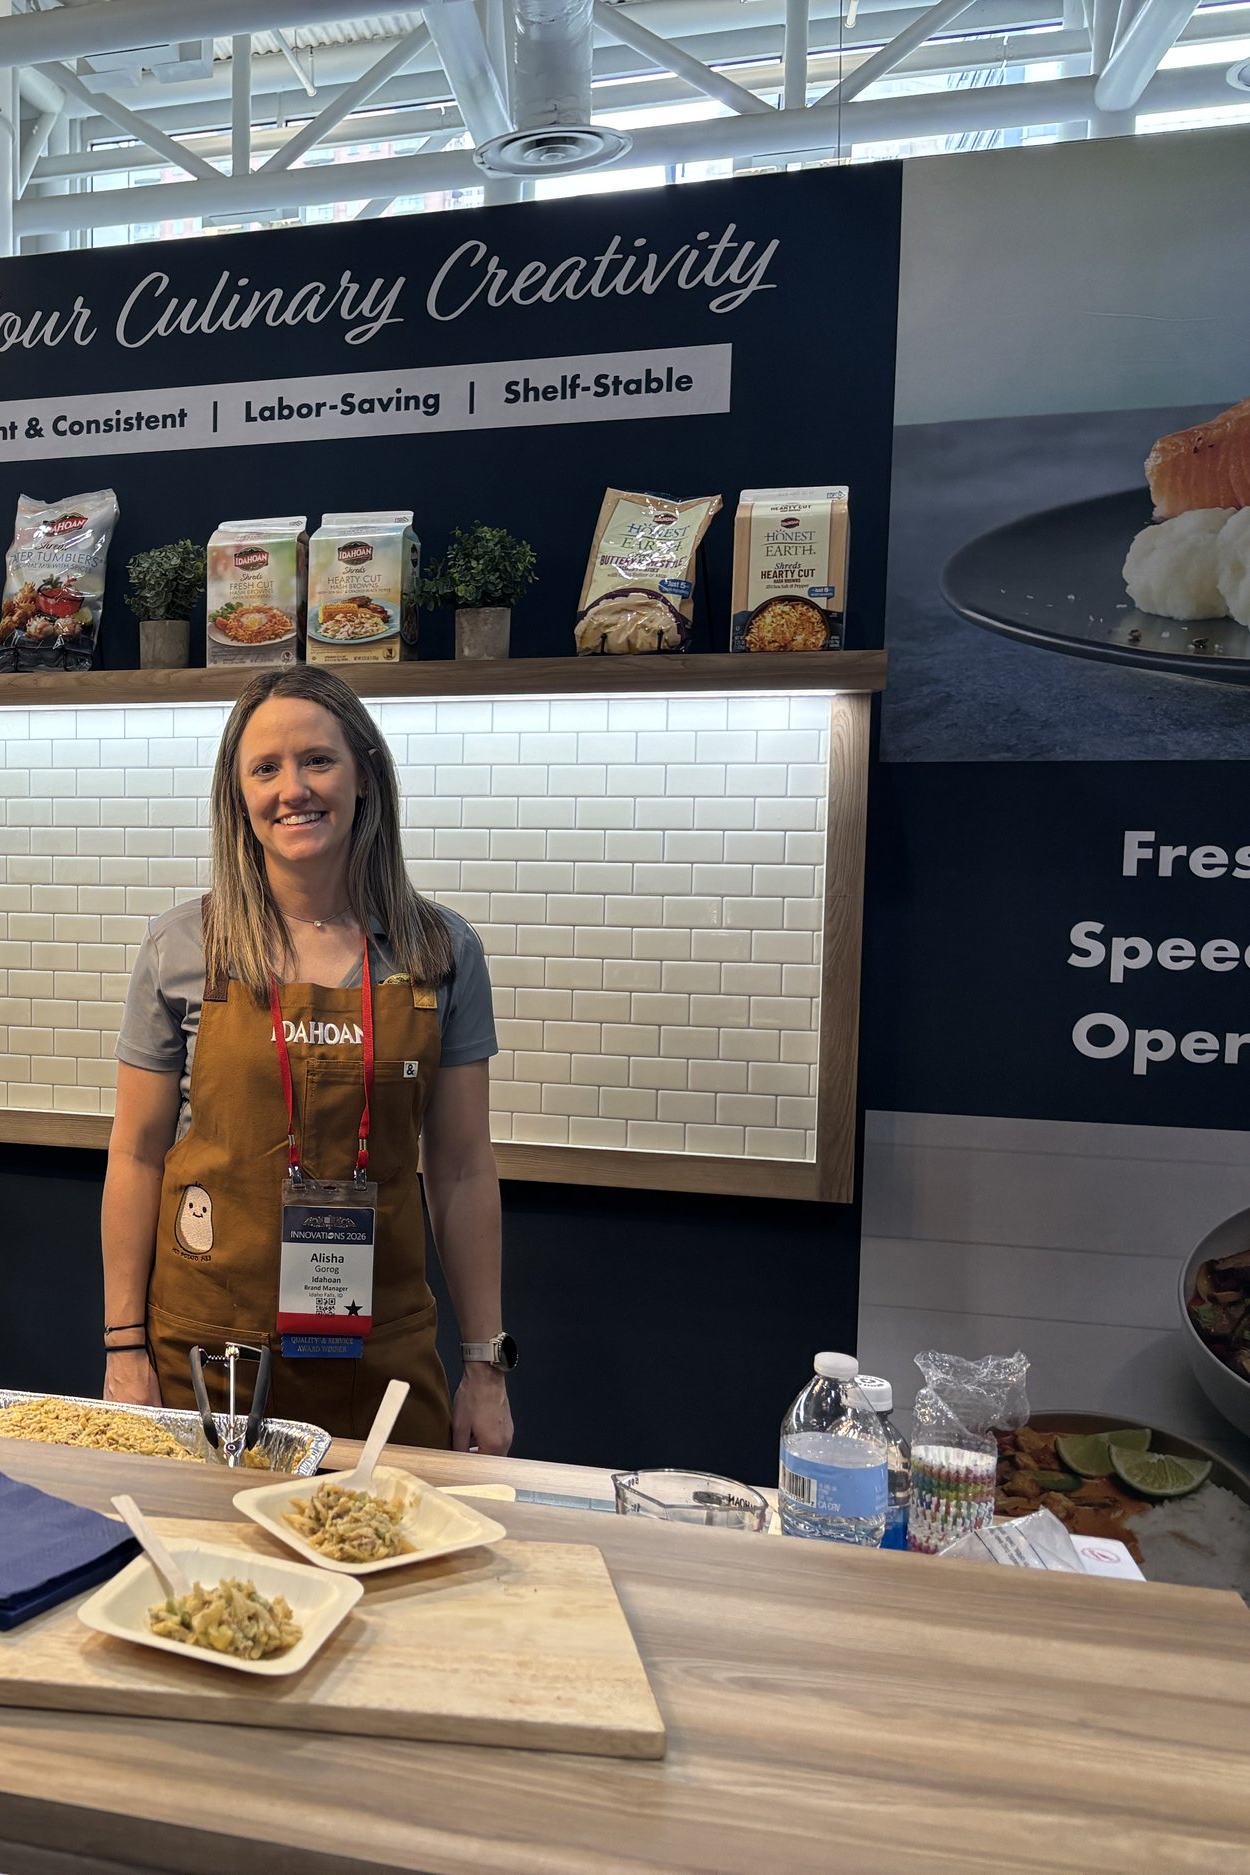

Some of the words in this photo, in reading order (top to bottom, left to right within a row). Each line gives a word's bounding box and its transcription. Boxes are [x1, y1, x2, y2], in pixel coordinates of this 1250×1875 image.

[116, 270, 405, 344] Culinary
[426, 223, 780, 320] Creativity
[504, 367, 693, 404] Shelf-Stable
[245, 387, 440, 423] Labor-Saving
[25, 417, 44, 438] &
[52, 408, 188, 436] Consistent
[765, 529, 815, 542] HONEST
[339, 548, 372, 560] IDAHOAN
[235, 554, 267, 566] IDAHOAN
[774, 562, 801, 570] Shreds
[761, 570, 794, 579] HEARTY
[798, 568, 816, 578] CUT
[327, 576, 361, 585] HEARTY
[363, 574, 382, 583] CUT
[230, 582, 254, 591] FRESH
[256, 580, 275, 589] CUT
[1067, 921, 1250, 983] Spee
[290, 1231, 346, 1240] INNOVATIONS
[346, 1232, 367, 1241] 2026
[310, 1253, 345, 1264] Alisha
[314, 1265, 340, 1275] Gorog
[311, 1276, 342, 1284] Idahoan
[290, 1336, 318, 1344] QUALITY
